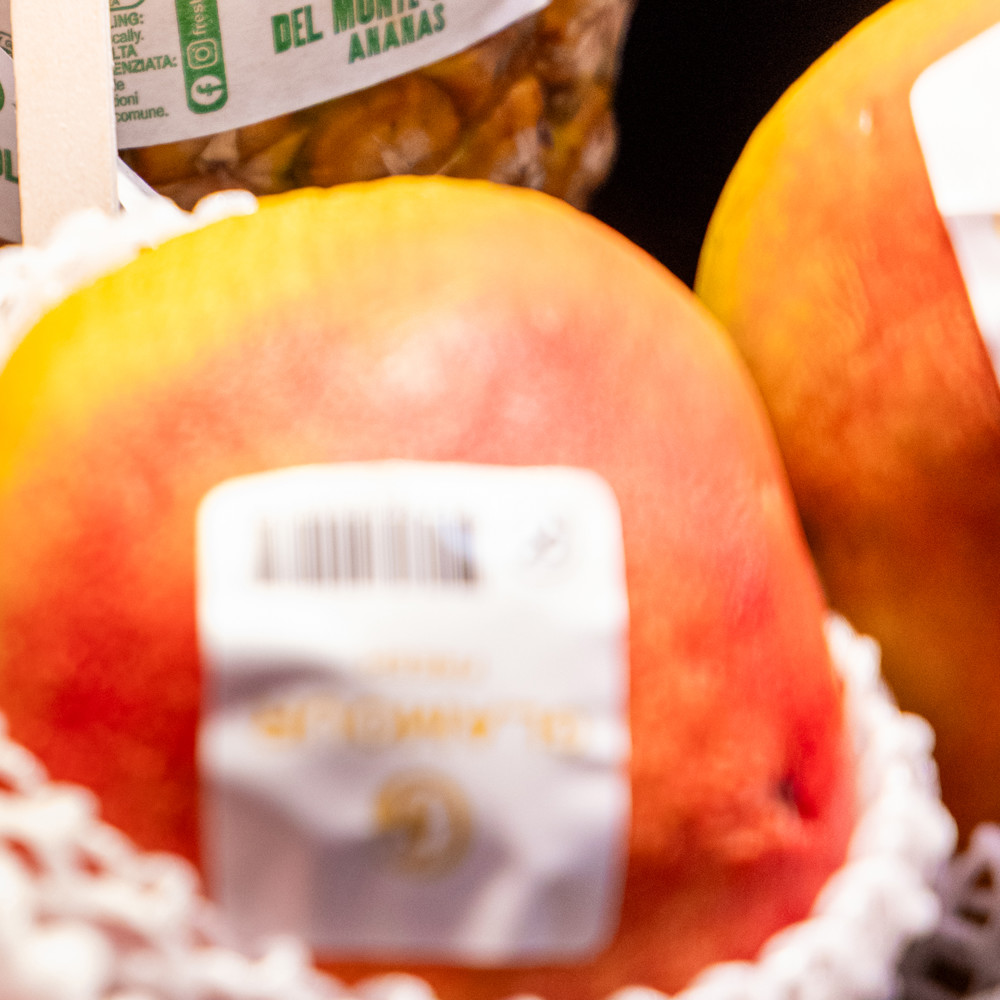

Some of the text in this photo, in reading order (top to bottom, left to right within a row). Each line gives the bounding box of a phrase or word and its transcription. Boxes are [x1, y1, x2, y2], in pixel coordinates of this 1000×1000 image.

[111, 12, 145, 29] ING:
[271, 3, 324, 55] DEL
[112, 28, 145, 45] cally.
[348, 2, 446, 65] ANANAS
[112, 43, 138, 60] LTA
[113, 54, 178, 76] ENZIATA:
